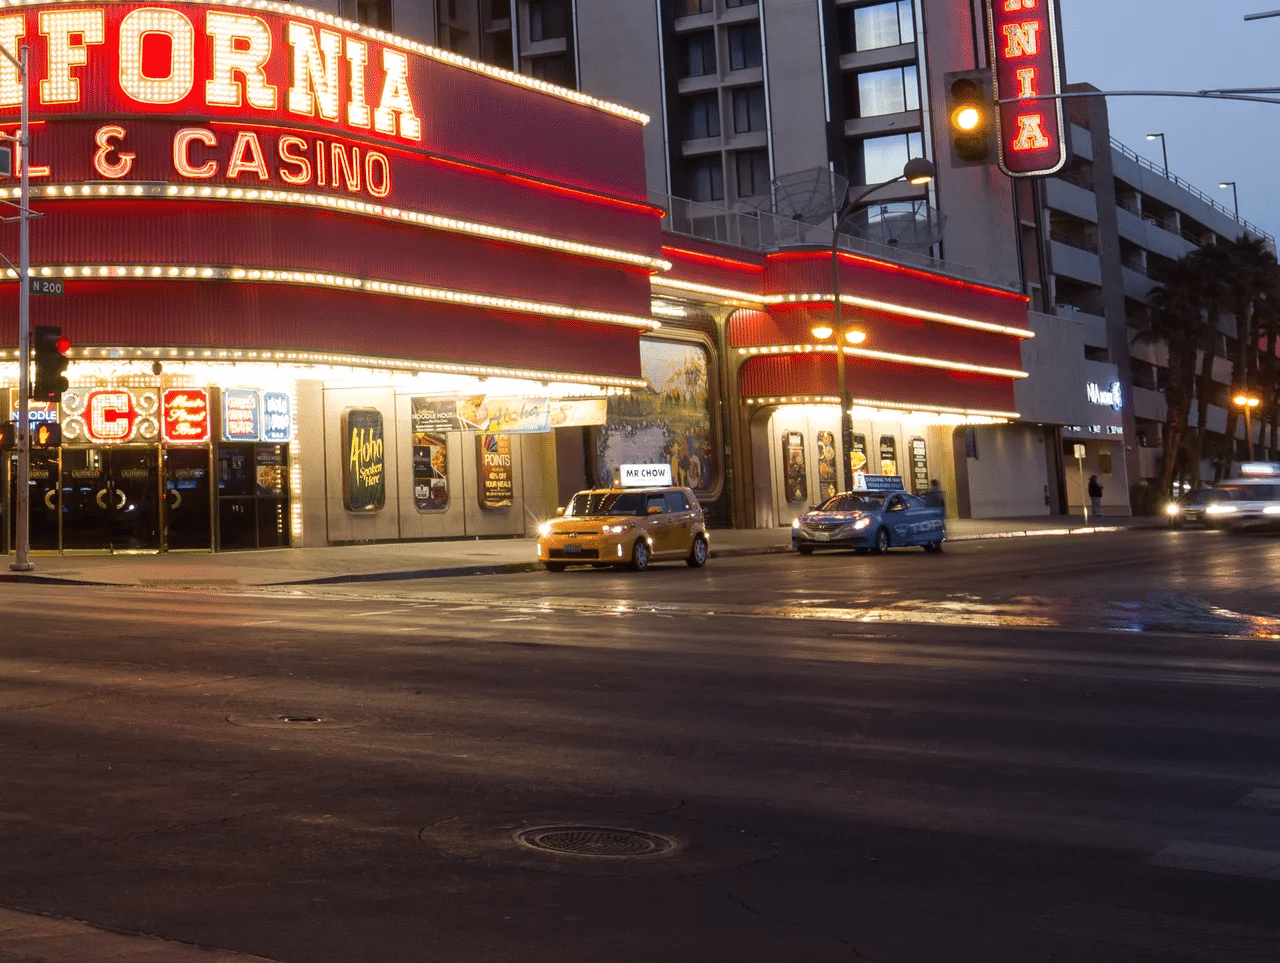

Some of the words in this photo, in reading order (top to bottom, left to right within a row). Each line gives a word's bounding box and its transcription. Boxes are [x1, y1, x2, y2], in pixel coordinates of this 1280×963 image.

[94, 125, 136, 179] &
[172, 127, 393, 198] CASINO
[33, 280, 40, 291] N
[42, 281, 62, 294] 200
[12, 411, 57, 420] NODLE
[91, 393, 129, 438] C
[484, 454, 511, 466] POINTS
[626, 469, 639, 478] MR
[641, 469, 666, 478] CHOW
